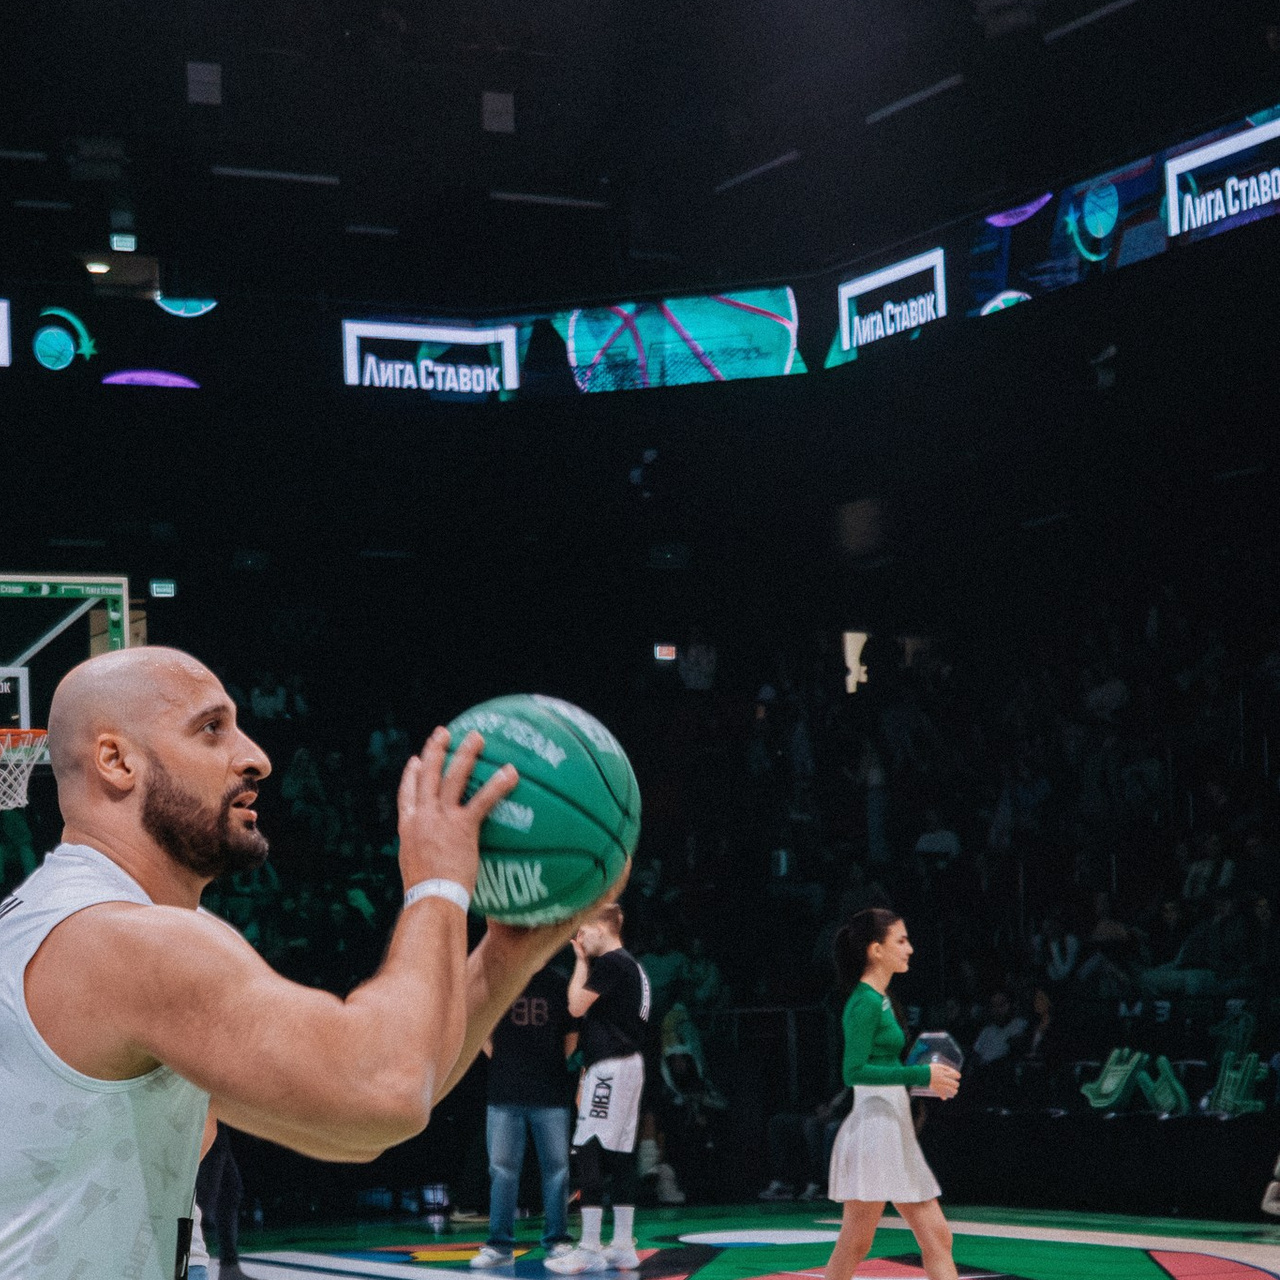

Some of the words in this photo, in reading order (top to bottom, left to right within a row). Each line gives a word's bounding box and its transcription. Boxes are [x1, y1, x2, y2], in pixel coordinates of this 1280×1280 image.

[1182, 187, 1226, 232] Лига
[852, 307, 885, 348] Лига
[884, 290, 937, 338] Ставок
[363, 355, 417, 390] Лига
[419, 358, 500, 394] Ставок
[473, 859, 549, 909] AVOK
